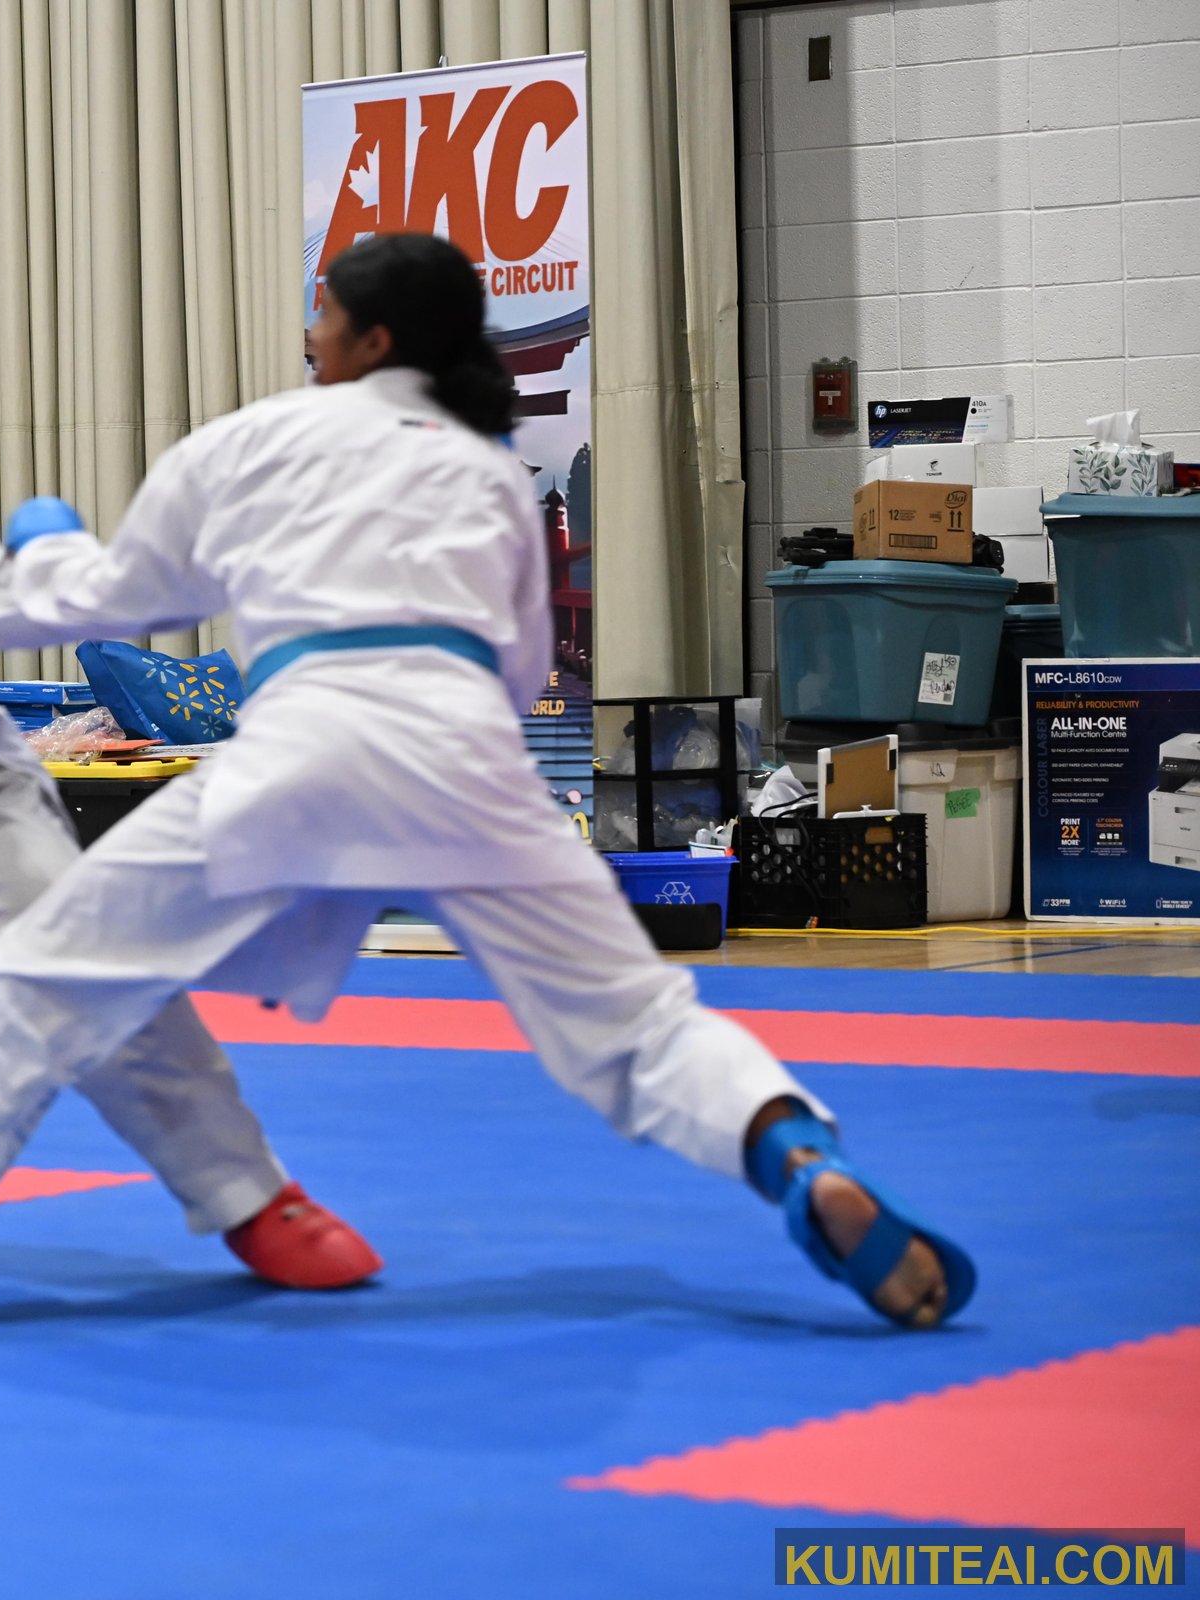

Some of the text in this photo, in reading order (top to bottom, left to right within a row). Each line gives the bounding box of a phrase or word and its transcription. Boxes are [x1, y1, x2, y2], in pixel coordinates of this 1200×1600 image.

[315, 79, 579, 277] AKC
[490, 261, 578, 297] CIRCUIT
[875, 406, 887, 418] hp
[889, 509, 899, 520] 12
[1034, 672, 1122, 684] MFC-L8610CDW
[530, 699, 565, 716] ORLD
[1036, 701, 1077, 709] RELIABILITY
[1086, 700, 1140, 709] PRODUCTIVITY
[1051, 717, 1127, 730] ALL-IN-ONE
[1102, 730, 1127, 738] Centre
[1036, 717, 1049, 817] COLOUR LASER
[1060, 818, 1080, 826] PRINT
[1061, 826, 1080, 839] 2X
[1050, 898, 1059, 907] 33
